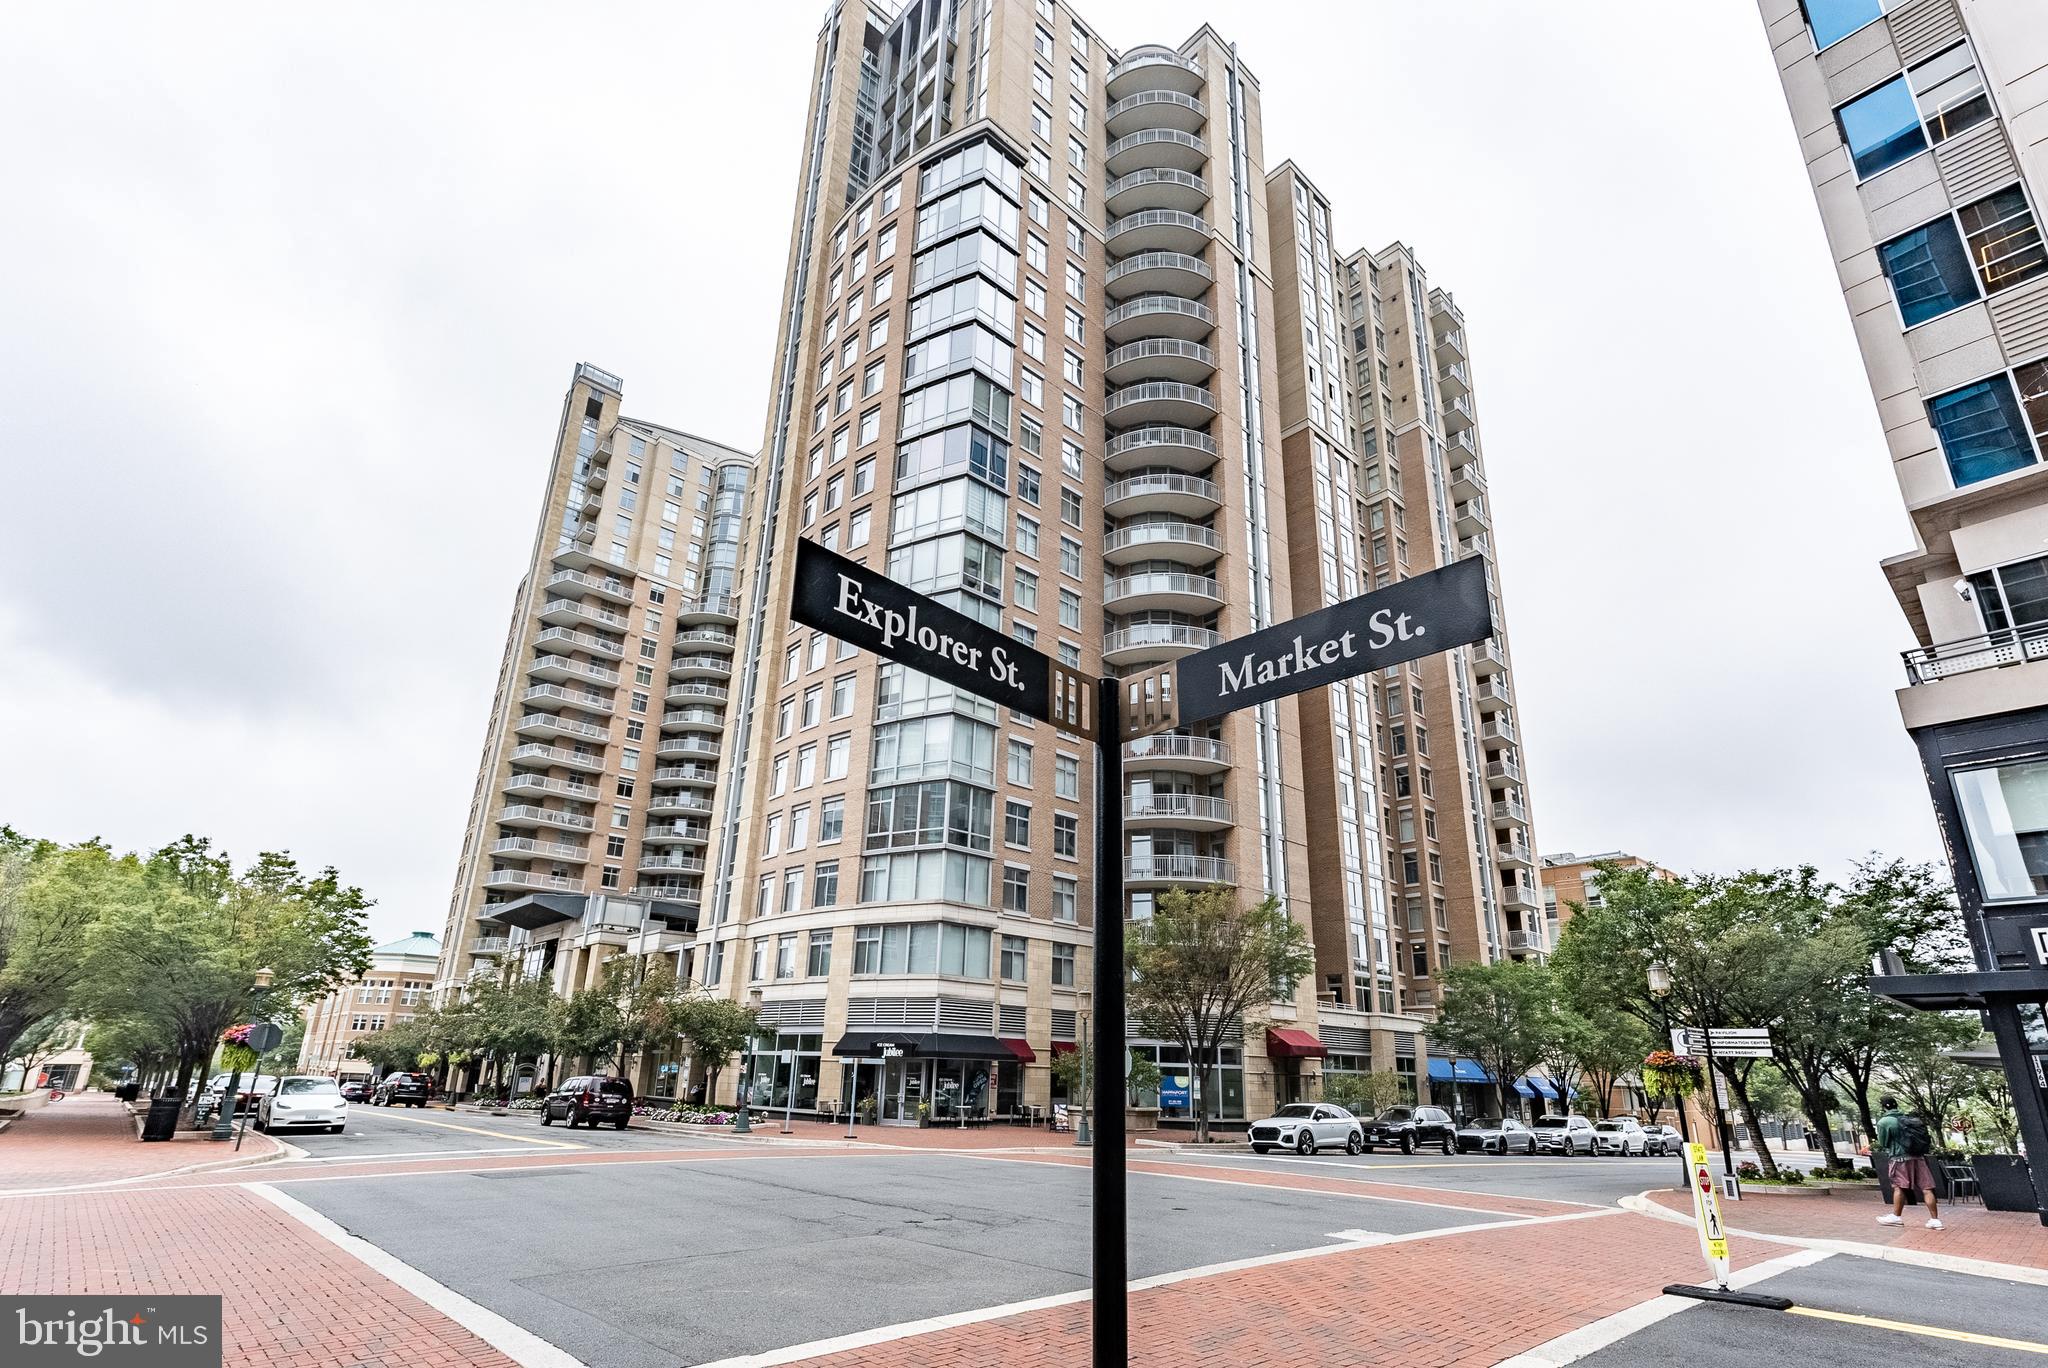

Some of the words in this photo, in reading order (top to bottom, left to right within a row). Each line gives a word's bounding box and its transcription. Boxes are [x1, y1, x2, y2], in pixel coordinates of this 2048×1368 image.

[833, 573, 982, 671] Explorer
[989, 646, 1025, 691] St.
[1218, 630, 1358, 697] Market
[1369, 608, 1426, 650] St.
[881, 1047, 904, 1059] jubilee
